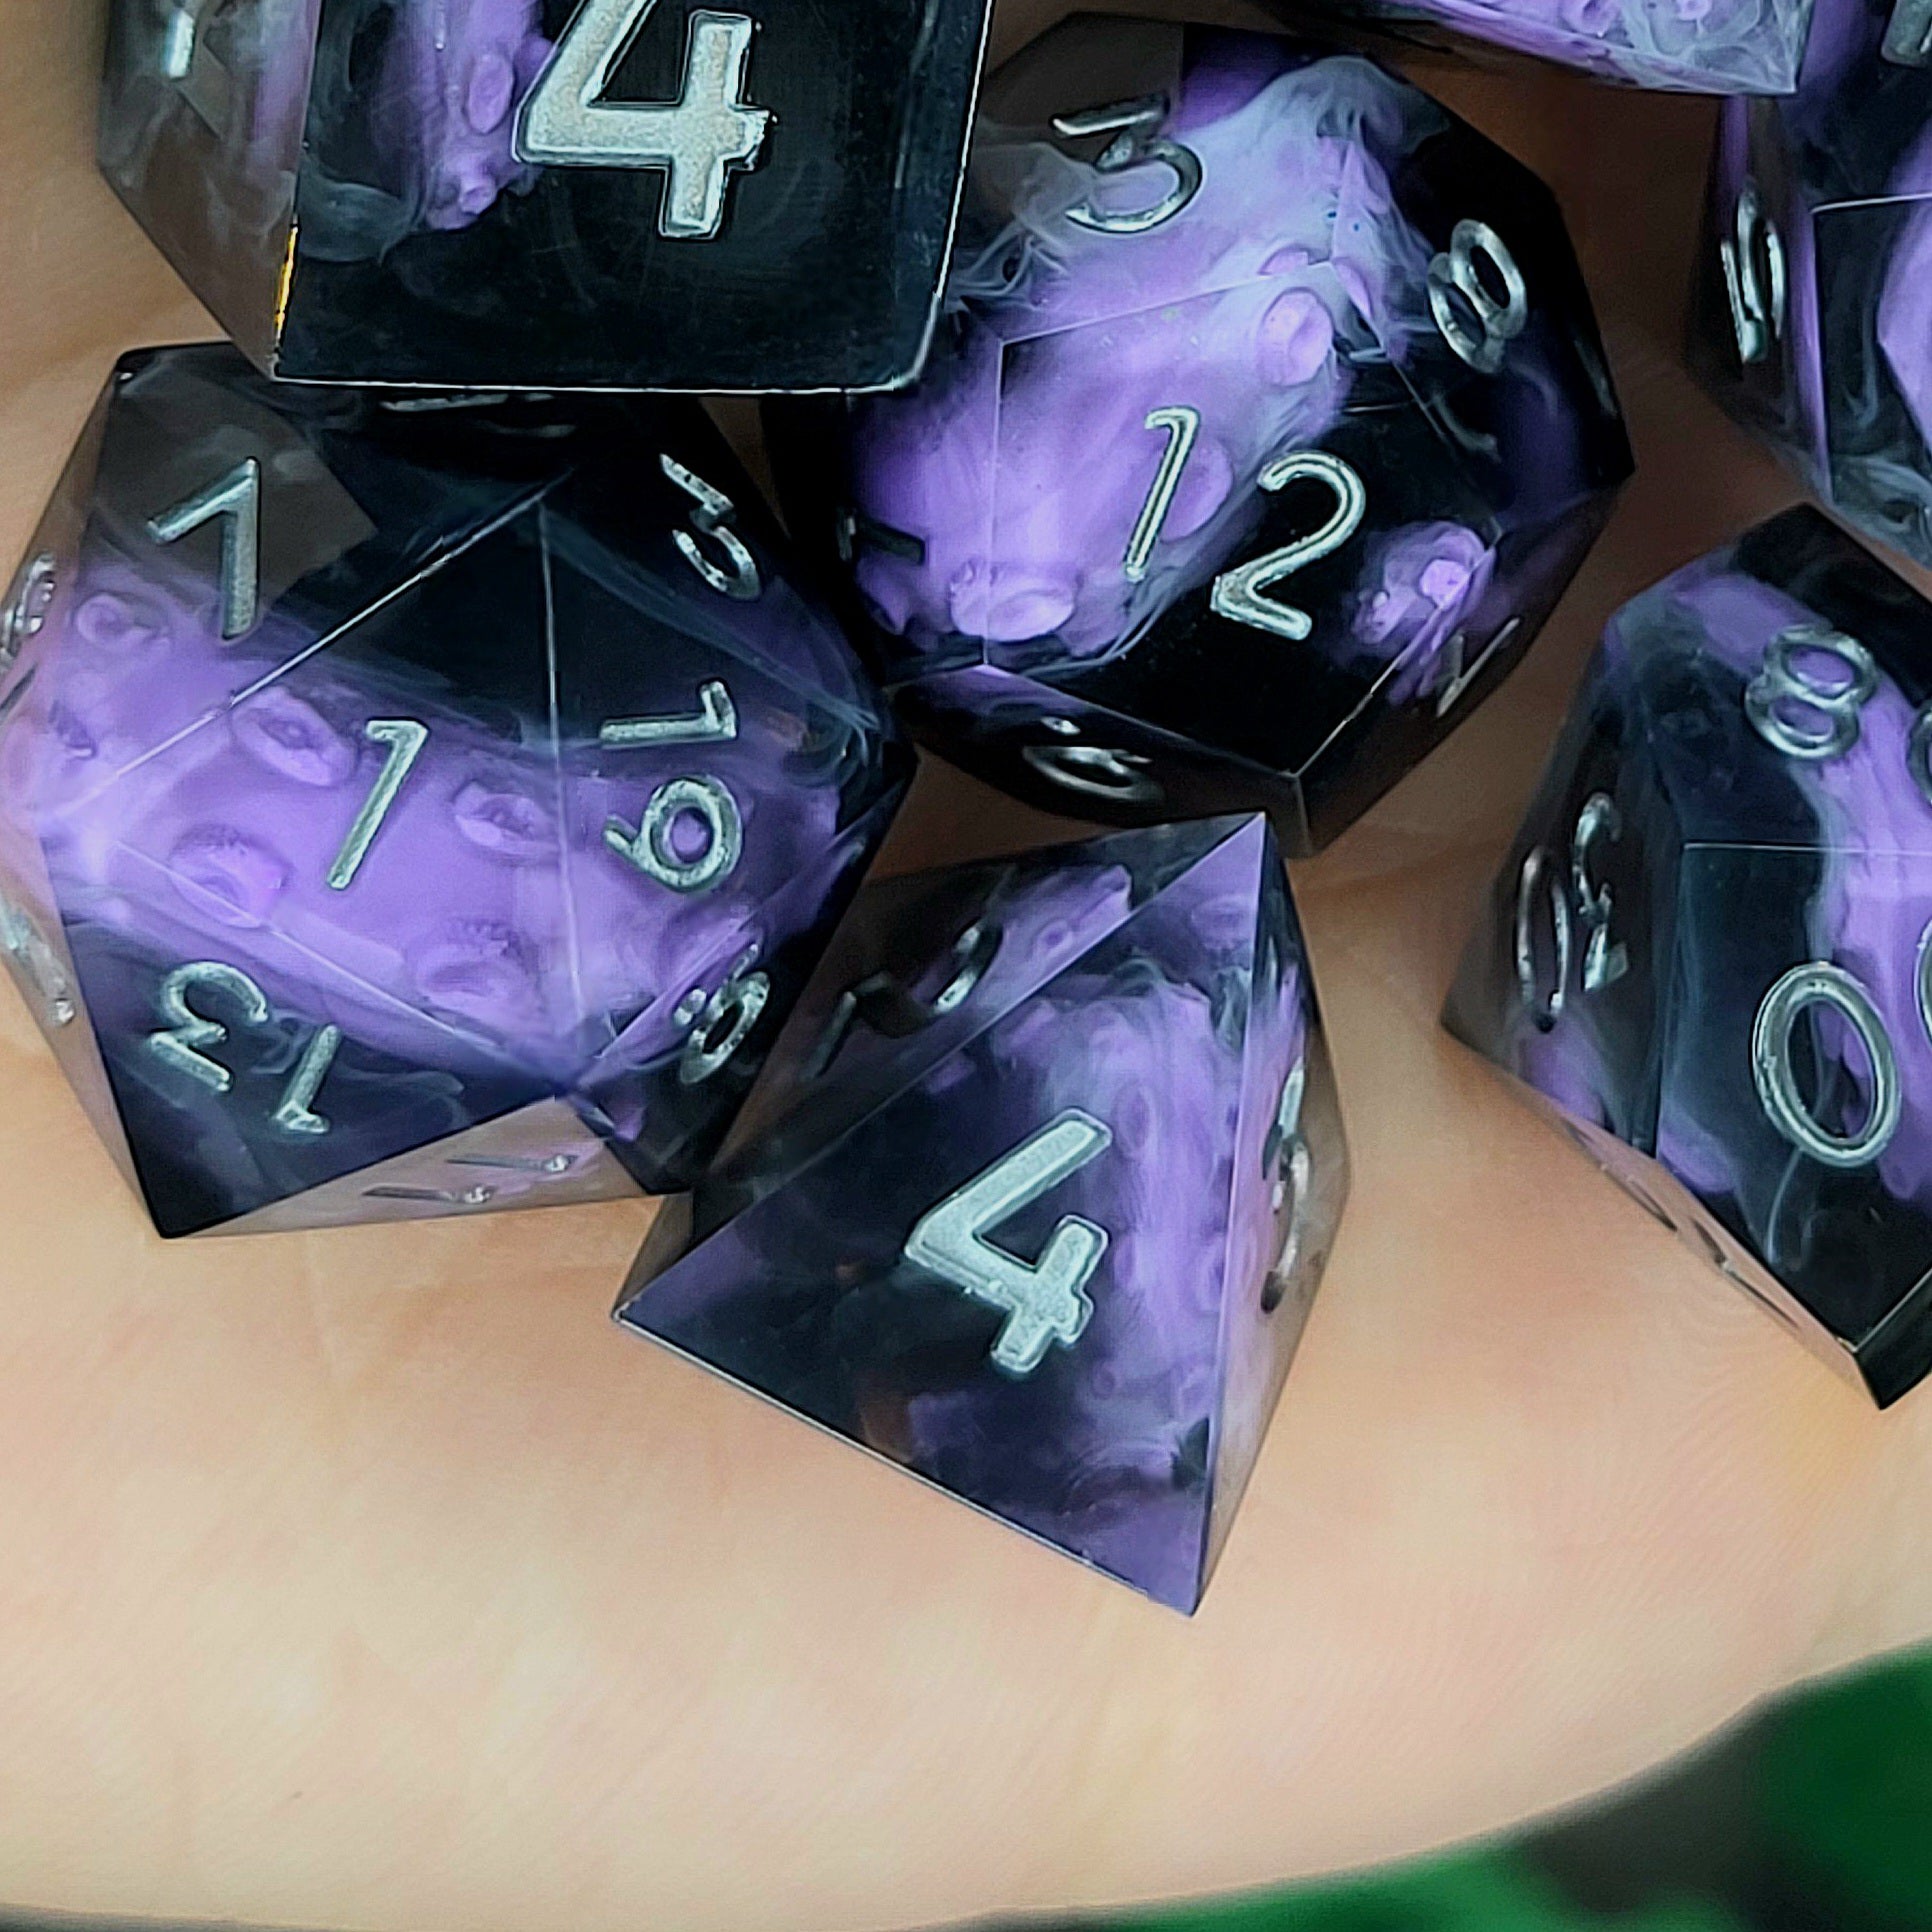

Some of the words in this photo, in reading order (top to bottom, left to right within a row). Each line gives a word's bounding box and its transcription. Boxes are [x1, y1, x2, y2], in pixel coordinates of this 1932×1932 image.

[511, 0, 776, 238] 4
[1123, 405, 1367, 640] 12
[1745, 625, 1932, 804] 8
[150, 960, 333, 1134] 13
[1751, 961, 1932, 1168] 0
[903, 1108, 1112, 1372] 4
